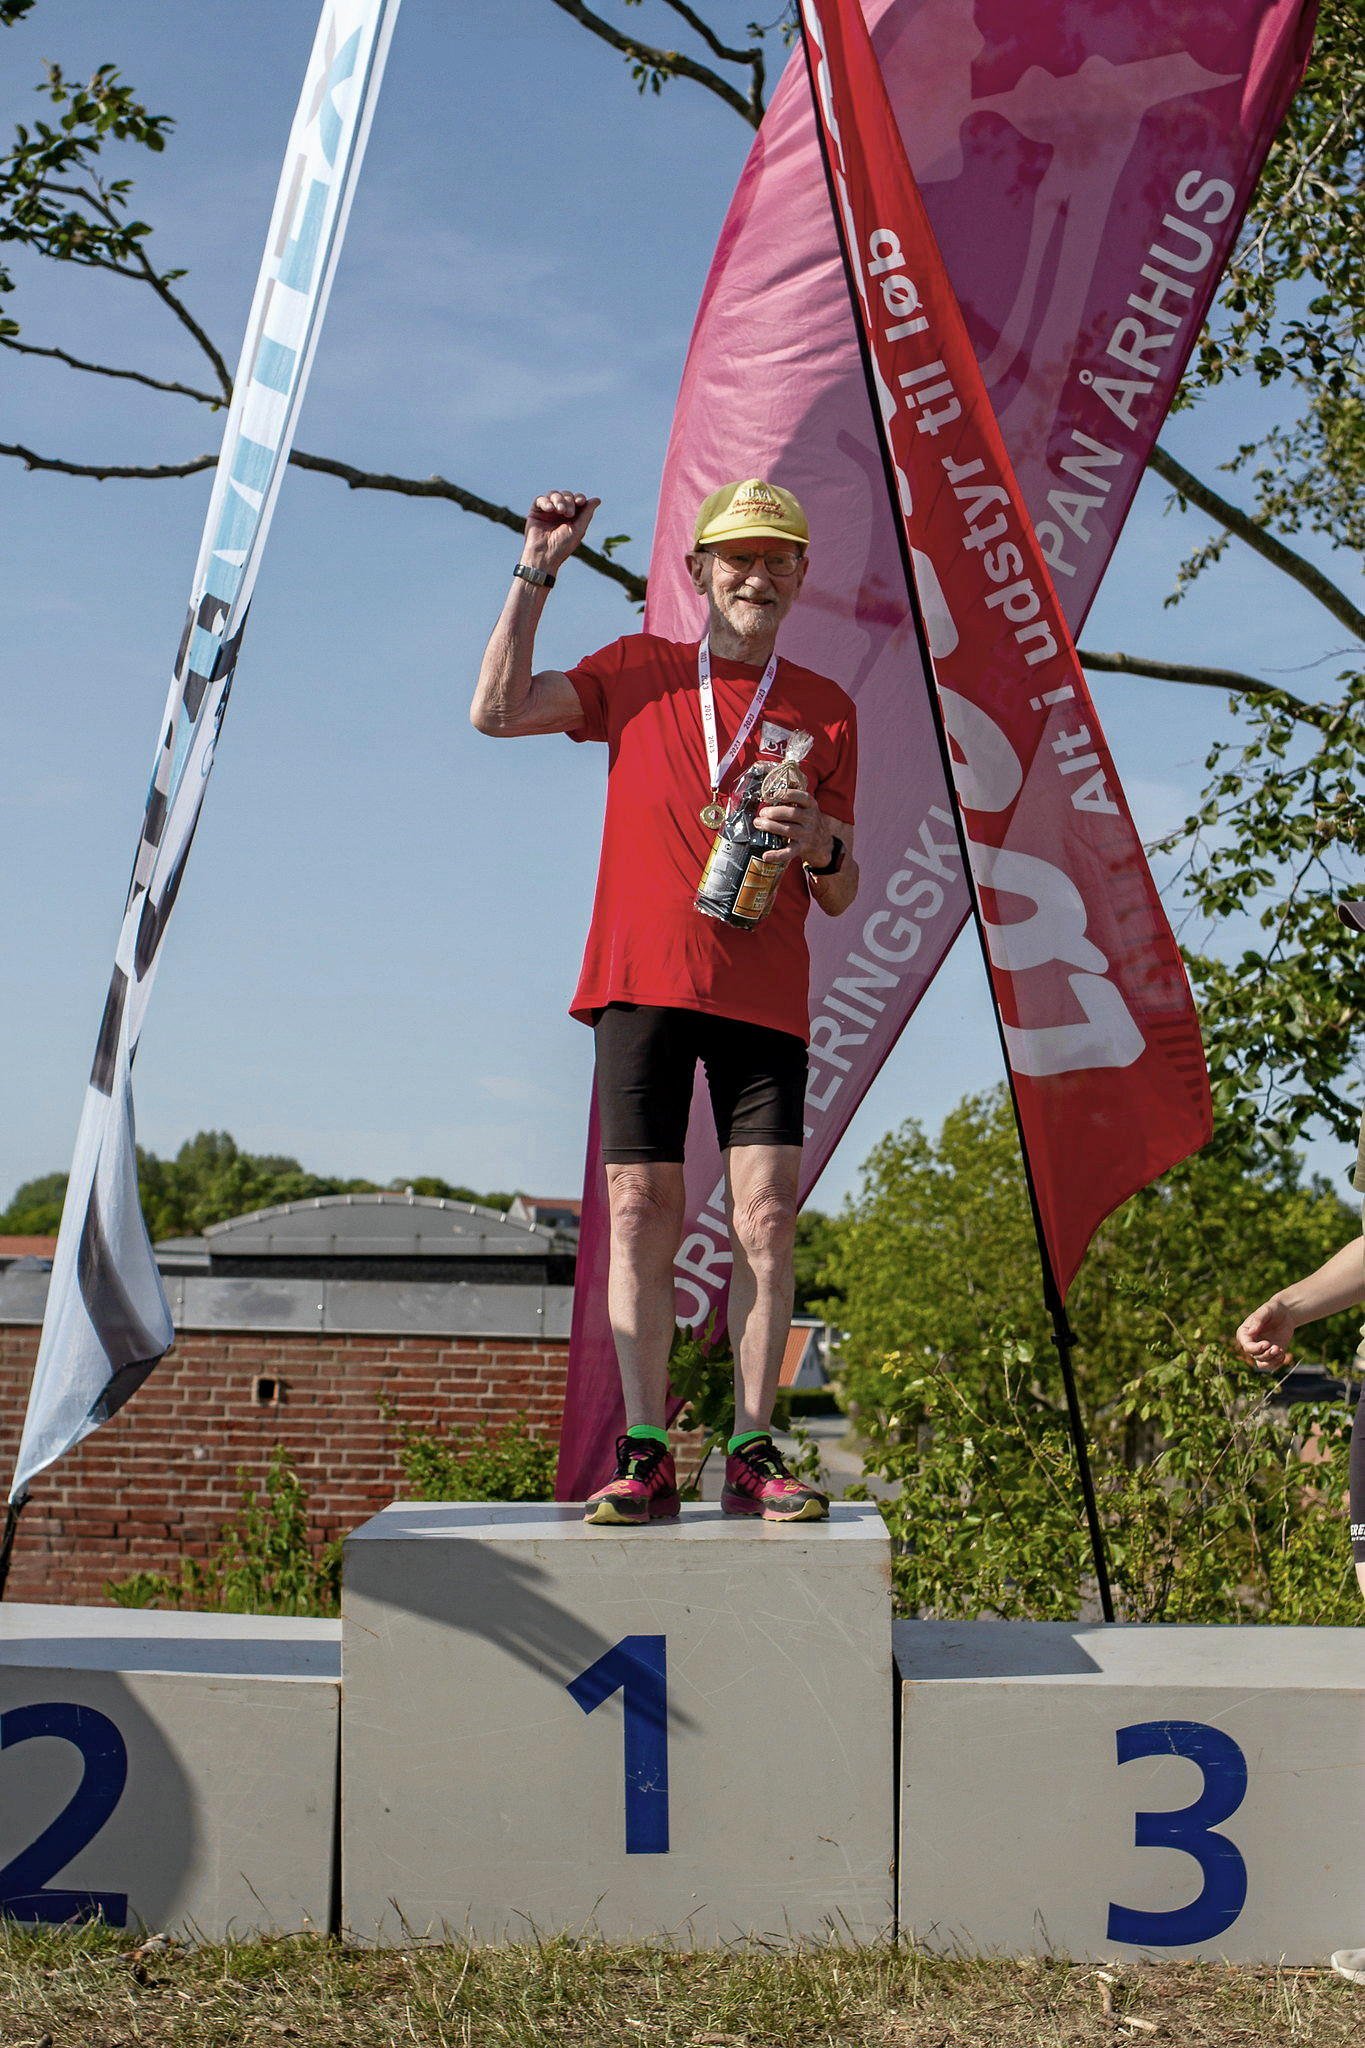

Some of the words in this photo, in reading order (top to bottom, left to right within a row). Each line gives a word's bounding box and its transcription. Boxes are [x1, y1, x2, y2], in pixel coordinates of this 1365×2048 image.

[866, 227, 930, 343] løb
[1078, 169, 1236, 431] ÅRHUS
[897, 358, 963, 437] til
[941, 454, 1059, 667] udstyr
[1036, 430, 1124, 579] PAN
[704, 704, 713, 721] 2023
[729, 740, 741, 757] 2023
[743, 713, 755, 730] 2023
[1029, 682, 1077, 713] i
[1050, 721, 1121, 816] Alt
[565, 1634, 670, 1855] 1
[0, 1702, 128, 1927] 2
[1107, 1719, 1248, 1947] 3
